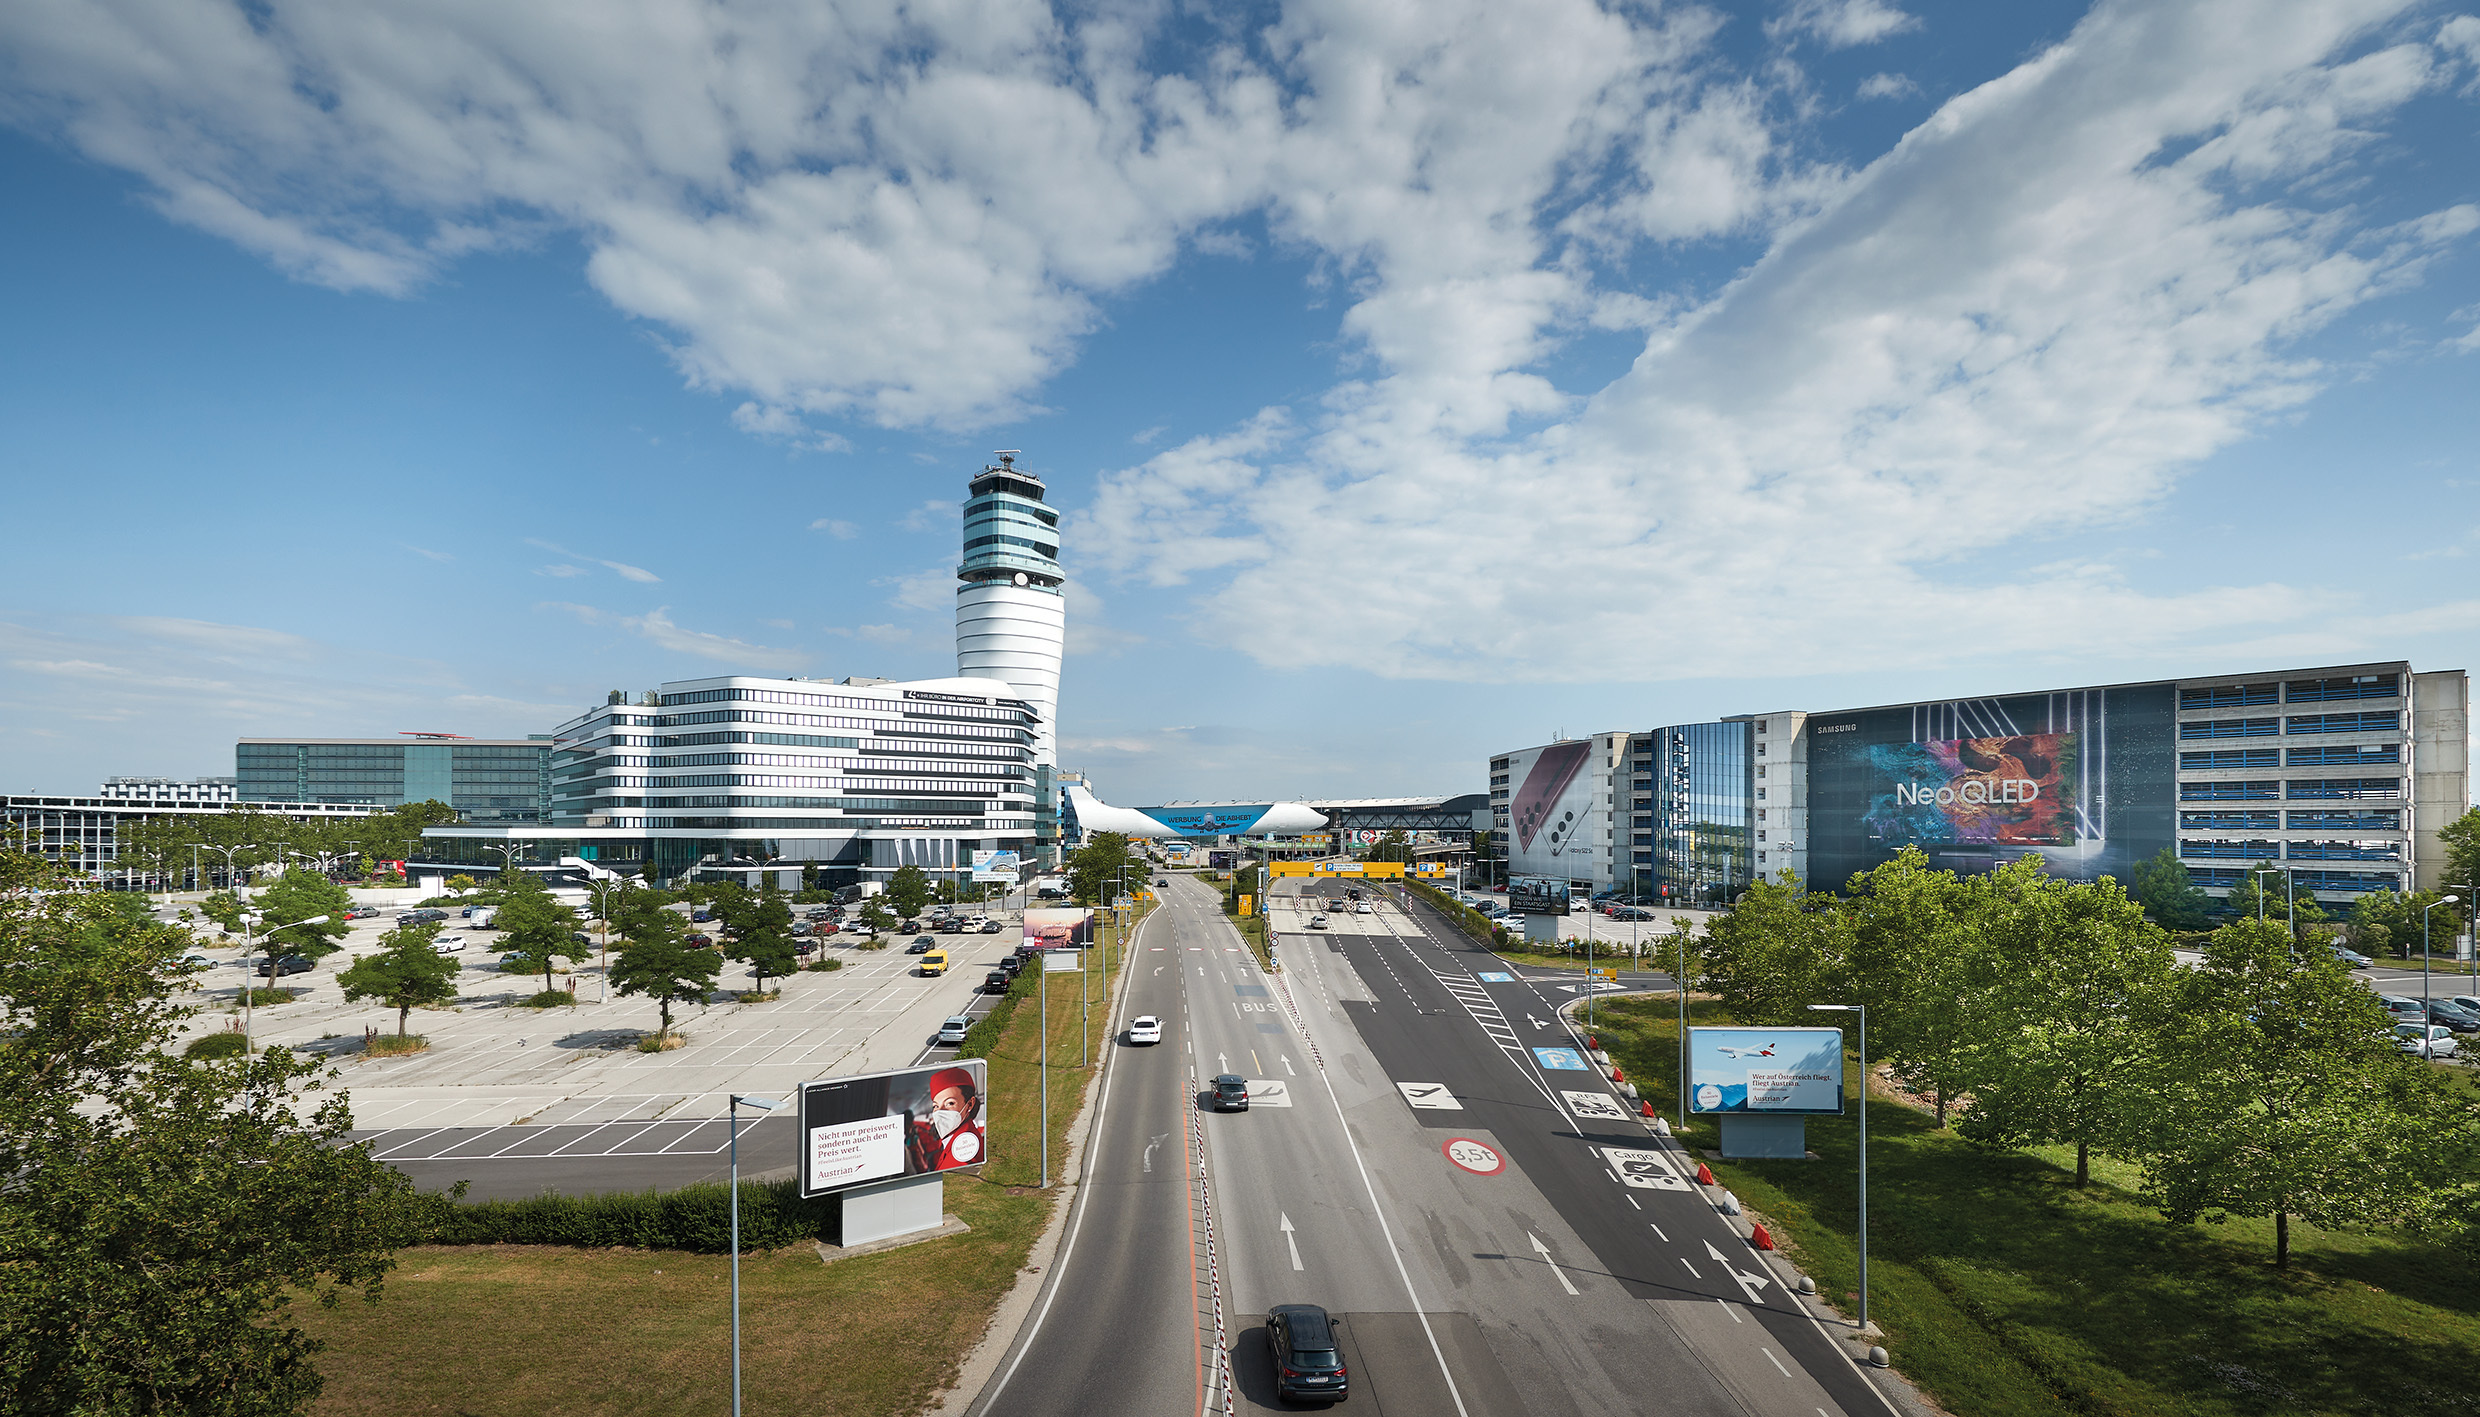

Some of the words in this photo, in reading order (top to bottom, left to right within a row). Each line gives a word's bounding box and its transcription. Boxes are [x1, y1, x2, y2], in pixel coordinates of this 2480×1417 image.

[1817, 723, 1857, 734] SAMSUNG
[1896, 782, 1955, 806] Neo
[1960, 779, 2040, 804] QLED
[1167, 816, 1202, 824] WERBUNG
[1241, 1002, 1278, 1012] BUS
[1546, 1054, 1567, 1068] P
[1570, 1058, 1584, 1069] 3
[1778, 1072, 1812, 1081] Österreich
[817, 1131, 840, 1142] Nicht
[842, 1129, 856, 1138] nur
[817, 1138, 851, 1151] sondern
[852, 1134, 872, 1144] auch
[873, 1132, 888, 1140] den
[817, 1148, 839, 1159] Preis
[840, 1145, 862, 1155] wert.
[1451, 1148, 1497, 1163] 3,5t
[1613, 1150, 1654, 1161] Cargo
[817, 1166, 853, 1179] Austrian
